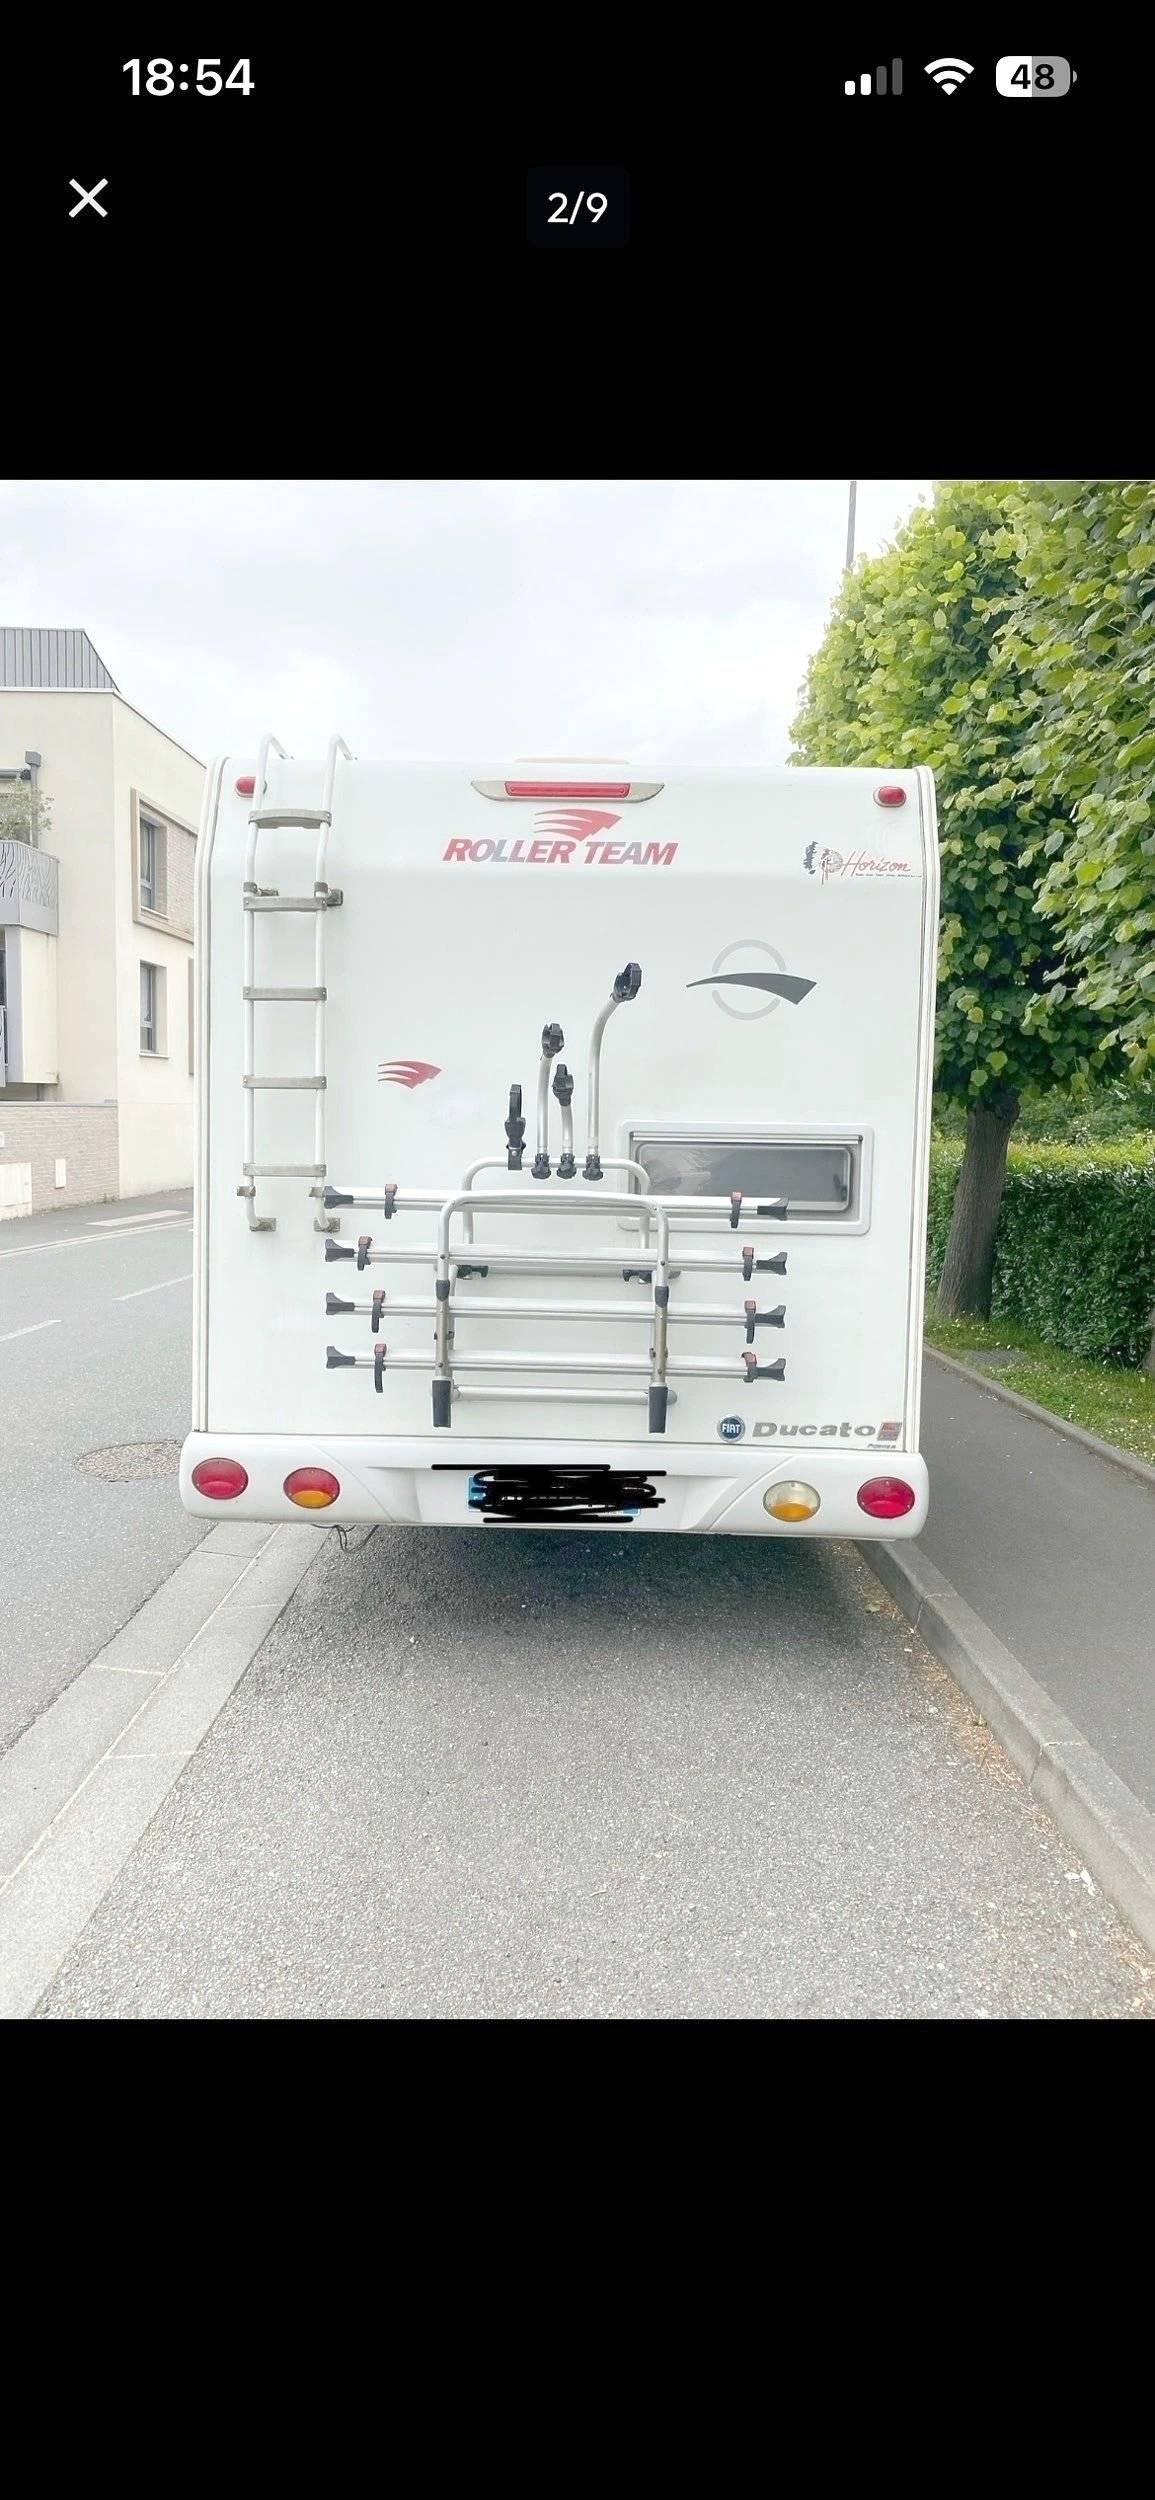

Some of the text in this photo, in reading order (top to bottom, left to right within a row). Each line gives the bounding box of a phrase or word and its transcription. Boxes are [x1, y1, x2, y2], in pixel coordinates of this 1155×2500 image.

[442, 838, 679, 866] ROLLER TEAM
[841, 850, 912, 877] Horizon
[721, 1422, 741, 1434] FIAT
[752, 1421, 876, 1438] Ducato
